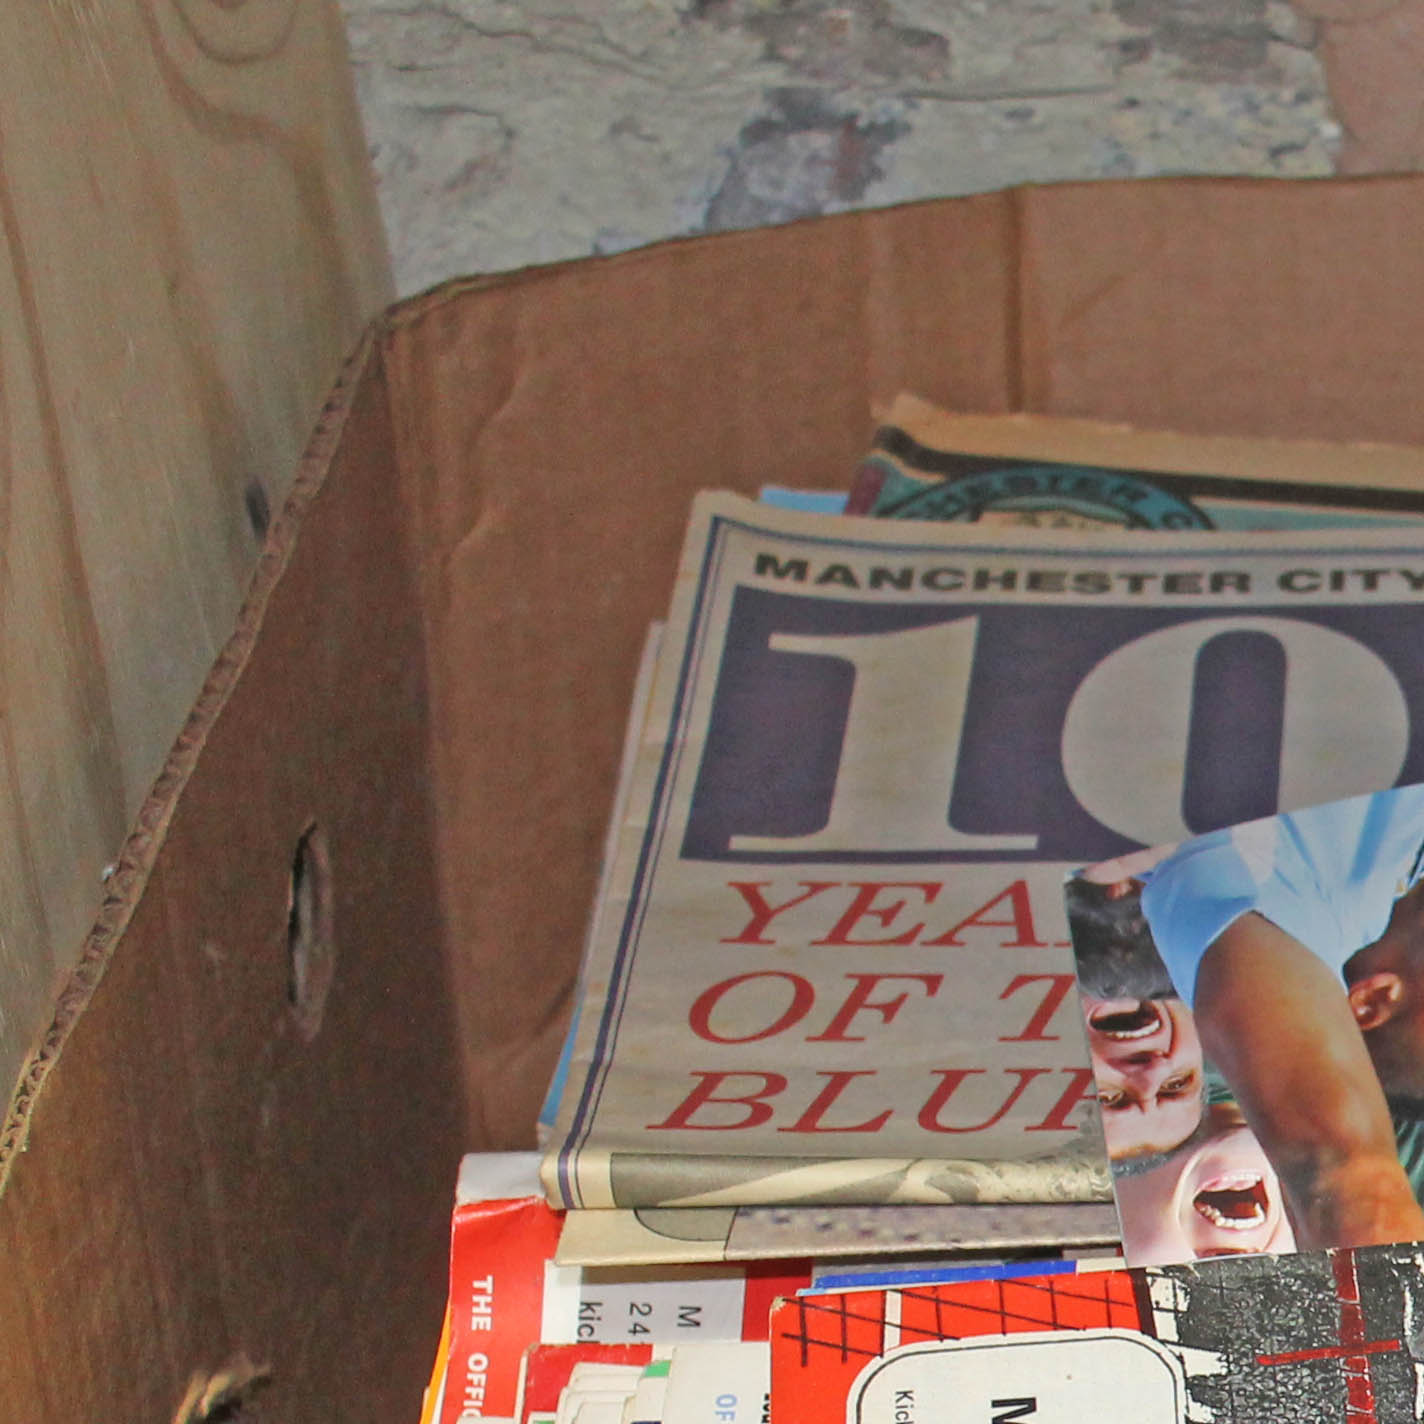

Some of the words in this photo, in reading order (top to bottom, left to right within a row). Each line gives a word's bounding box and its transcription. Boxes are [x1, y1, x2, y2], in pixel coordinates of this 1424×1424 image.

[753, 553, 1252, 595] MANCHESTER
[719, 879, 1071, 948] YEA
[687, 971, 945, 1045] OF
[471, 1275, 493, 1332] THE
